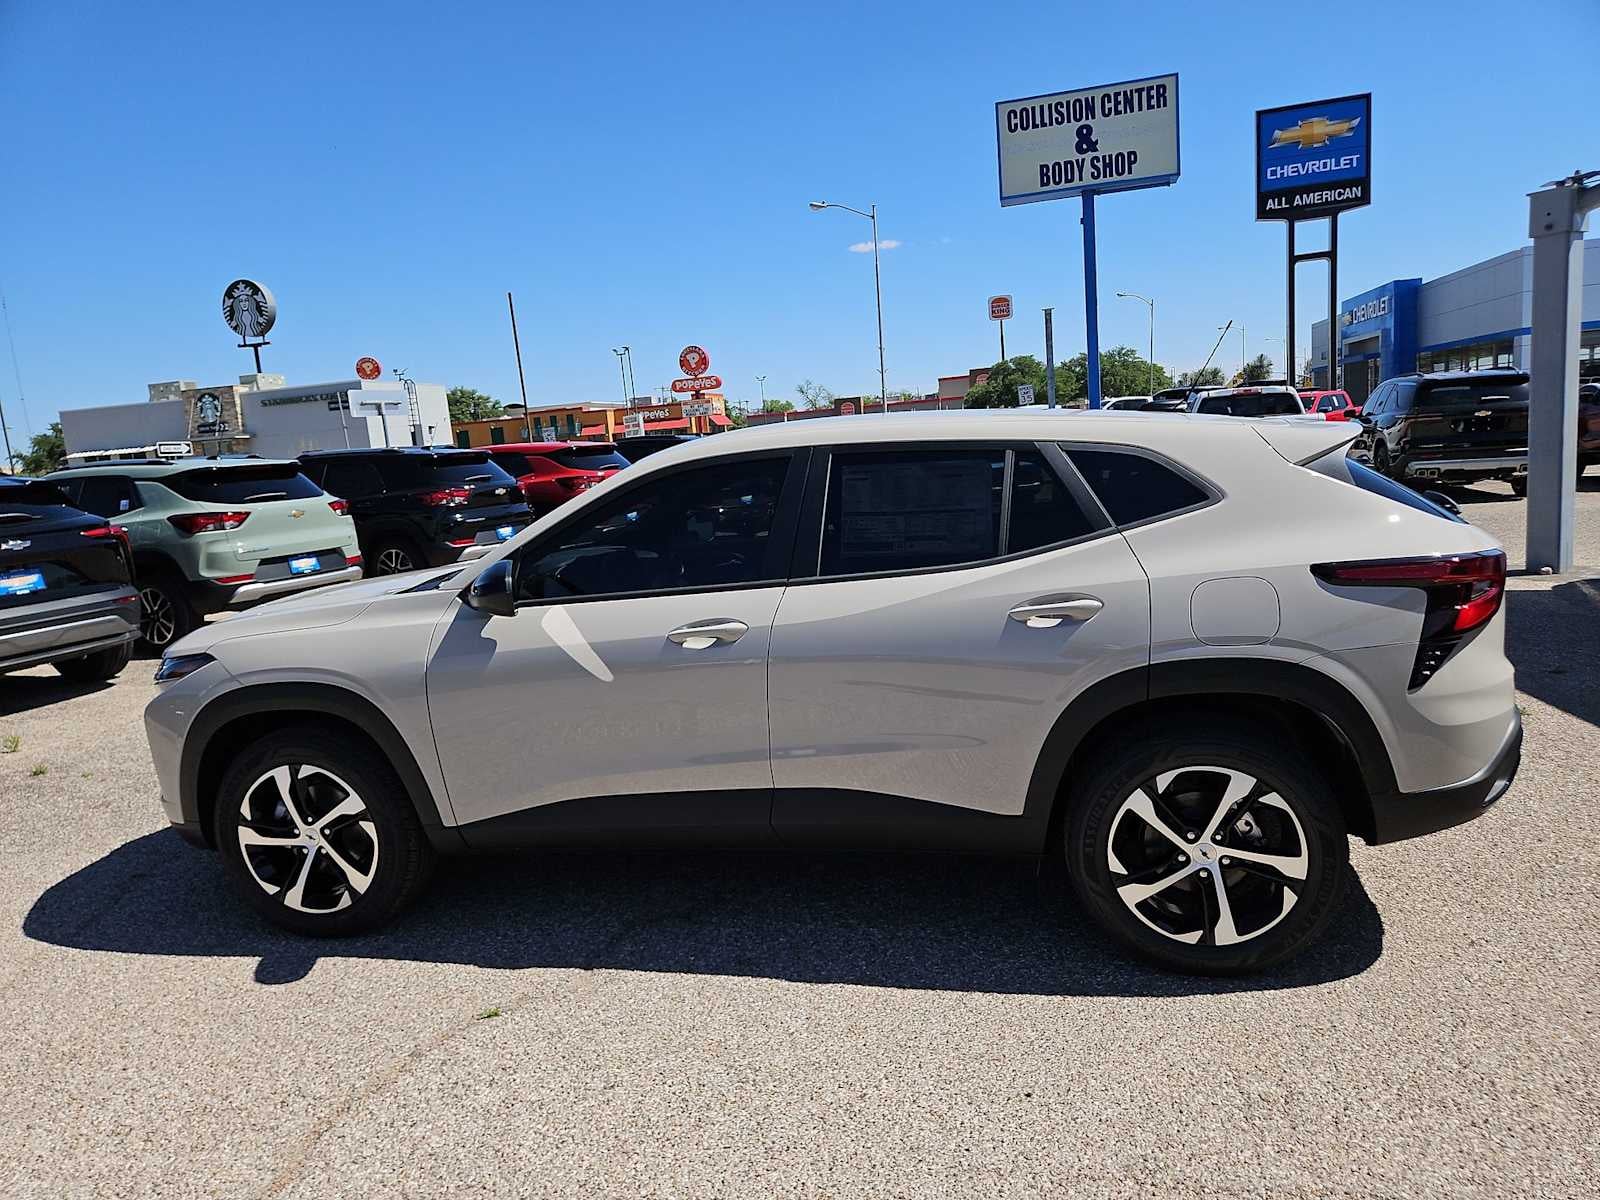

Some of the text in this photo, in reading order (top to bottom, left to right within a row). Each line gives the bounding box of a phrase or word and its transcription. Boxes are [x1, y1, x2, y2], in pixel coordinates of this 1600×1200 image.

[1007, 84, 1168, 133] COLLISION CENTER
[1075, 124, 1099, 155] &
[1040, 150, 1138, 187] BODY SHOP
[1267, 154, 1360, 180] CHEVROLET
[1266, 186, 1362, 210] ALL AMERICAN
[1353, 296, 1389, 324] CHEVROLET
